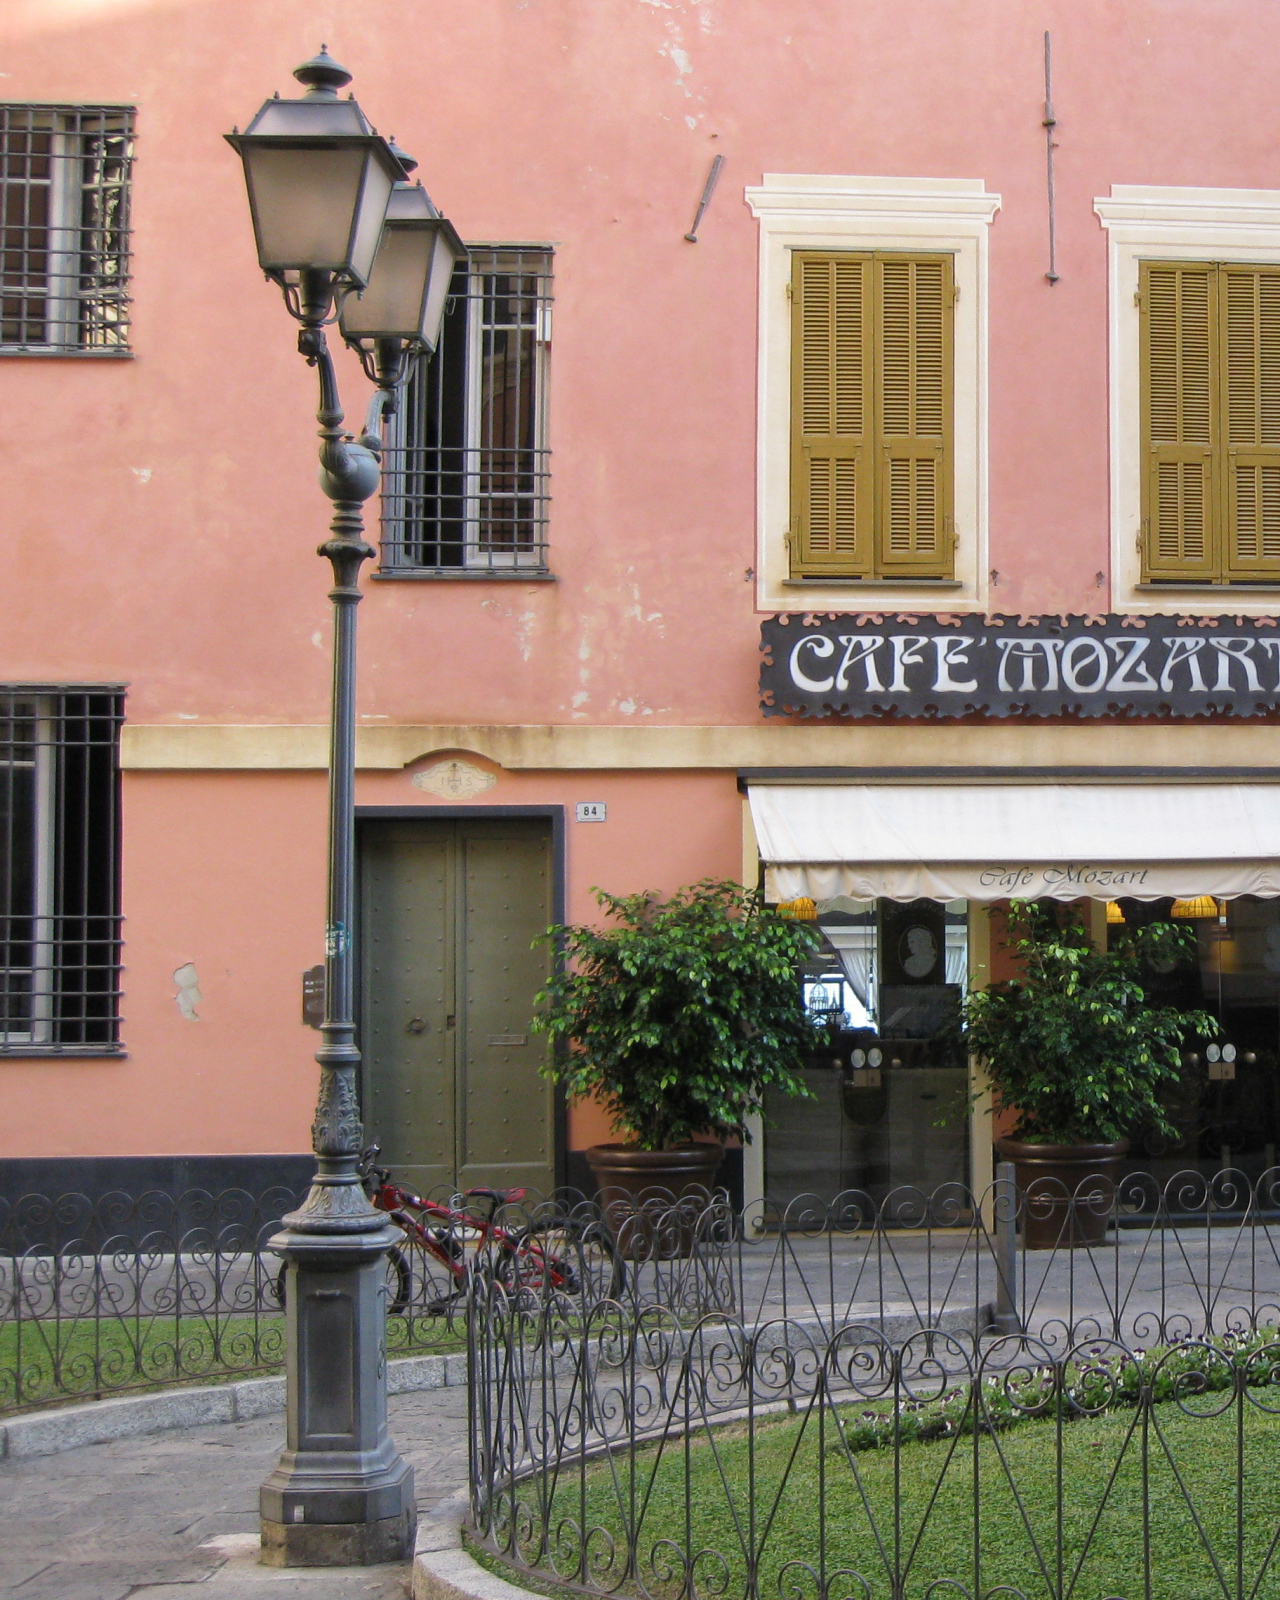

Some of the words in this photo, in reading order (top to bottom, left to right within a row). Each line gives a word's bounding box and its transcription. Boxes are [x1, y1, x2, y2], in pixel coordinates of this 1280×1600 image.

[583, 805, 597, 816] 84
[979, 866, 1034, 893] Cafe
[1042, 864, 1149, 886] Mozart
